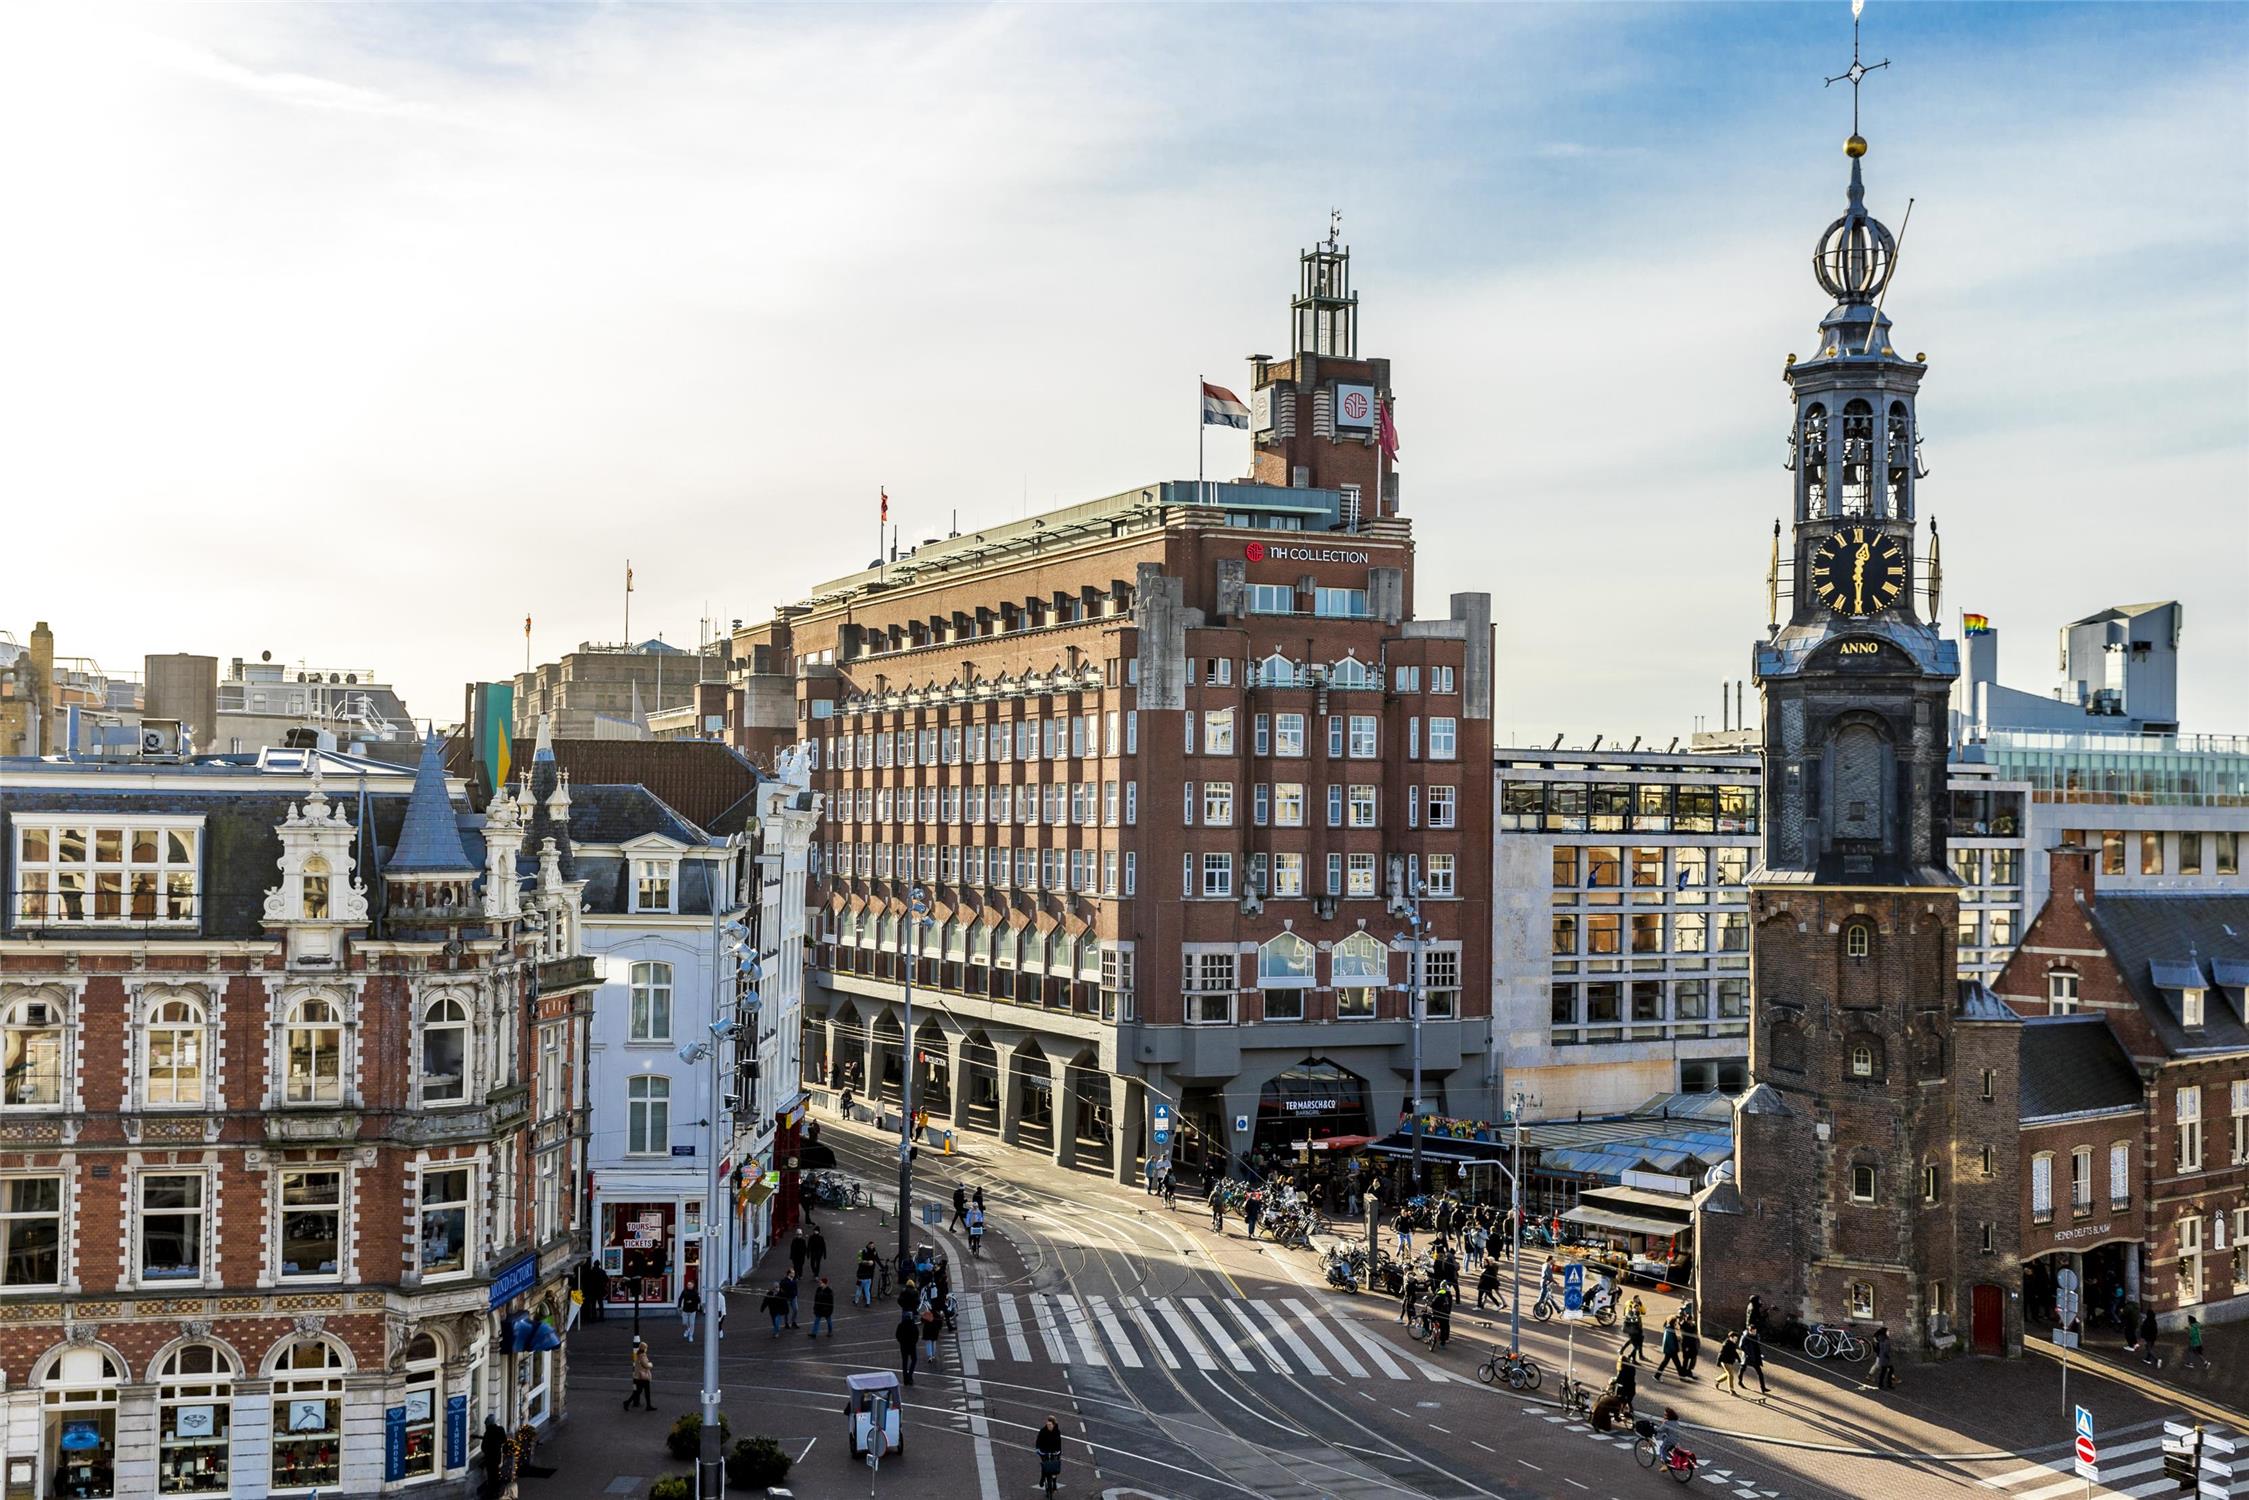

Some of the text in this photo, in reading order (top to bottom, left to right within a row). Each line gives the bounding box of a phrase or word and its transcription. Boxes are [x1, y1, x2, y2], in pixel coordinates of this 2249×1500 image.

[1290, 548, 1368, 563] COLLECTION
[1840, 642, 1878, 654] ANNO
[627, 1223, 650, 1231] TOURS
[624, 1240, 653, 1248] TICKETS
[510, 1261, 534, 1289] FACTORY
